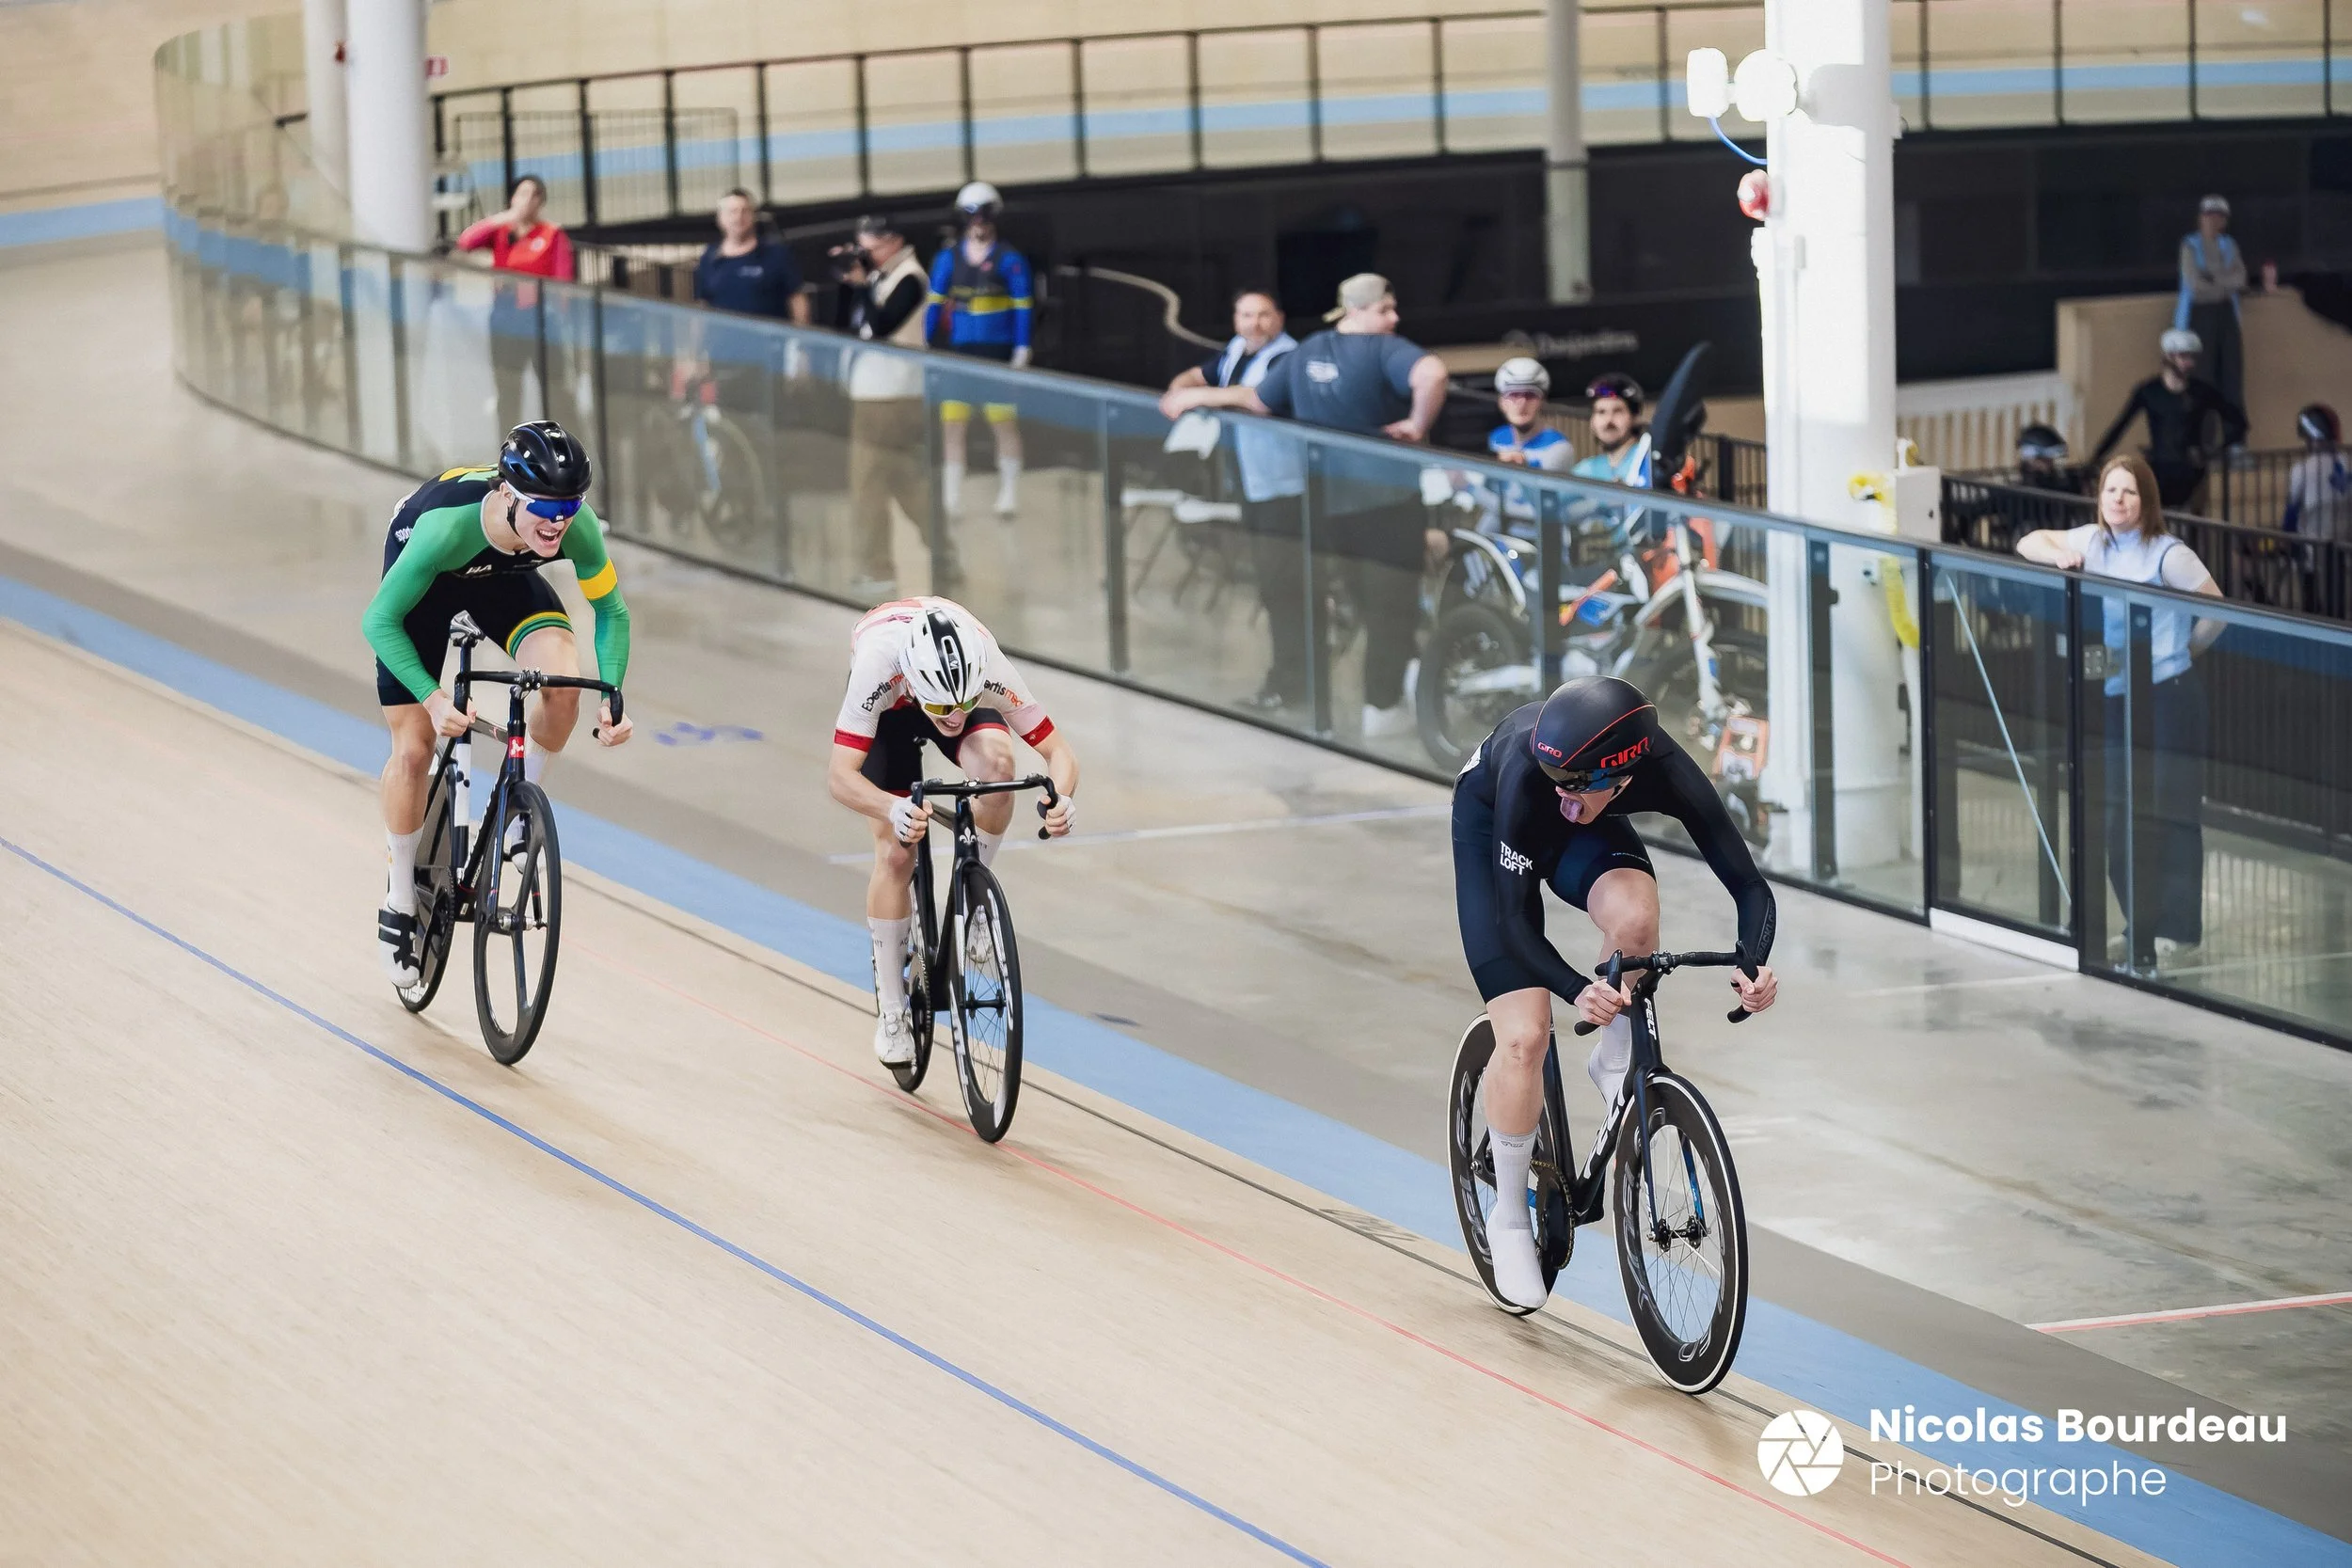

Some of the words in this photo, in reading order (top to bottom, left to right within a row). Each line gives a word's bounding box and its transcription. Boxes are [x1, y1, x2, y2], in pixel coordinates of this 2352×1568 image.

[1538, 741, 1563, 758] GIRO
[1600, 736, 1650, 768] GIRO
[1500, 840, 1534, 871] TRACK
[1500, 853, 1526, 876] LOFT
[1644, 997, 1657, 1040] FELT
